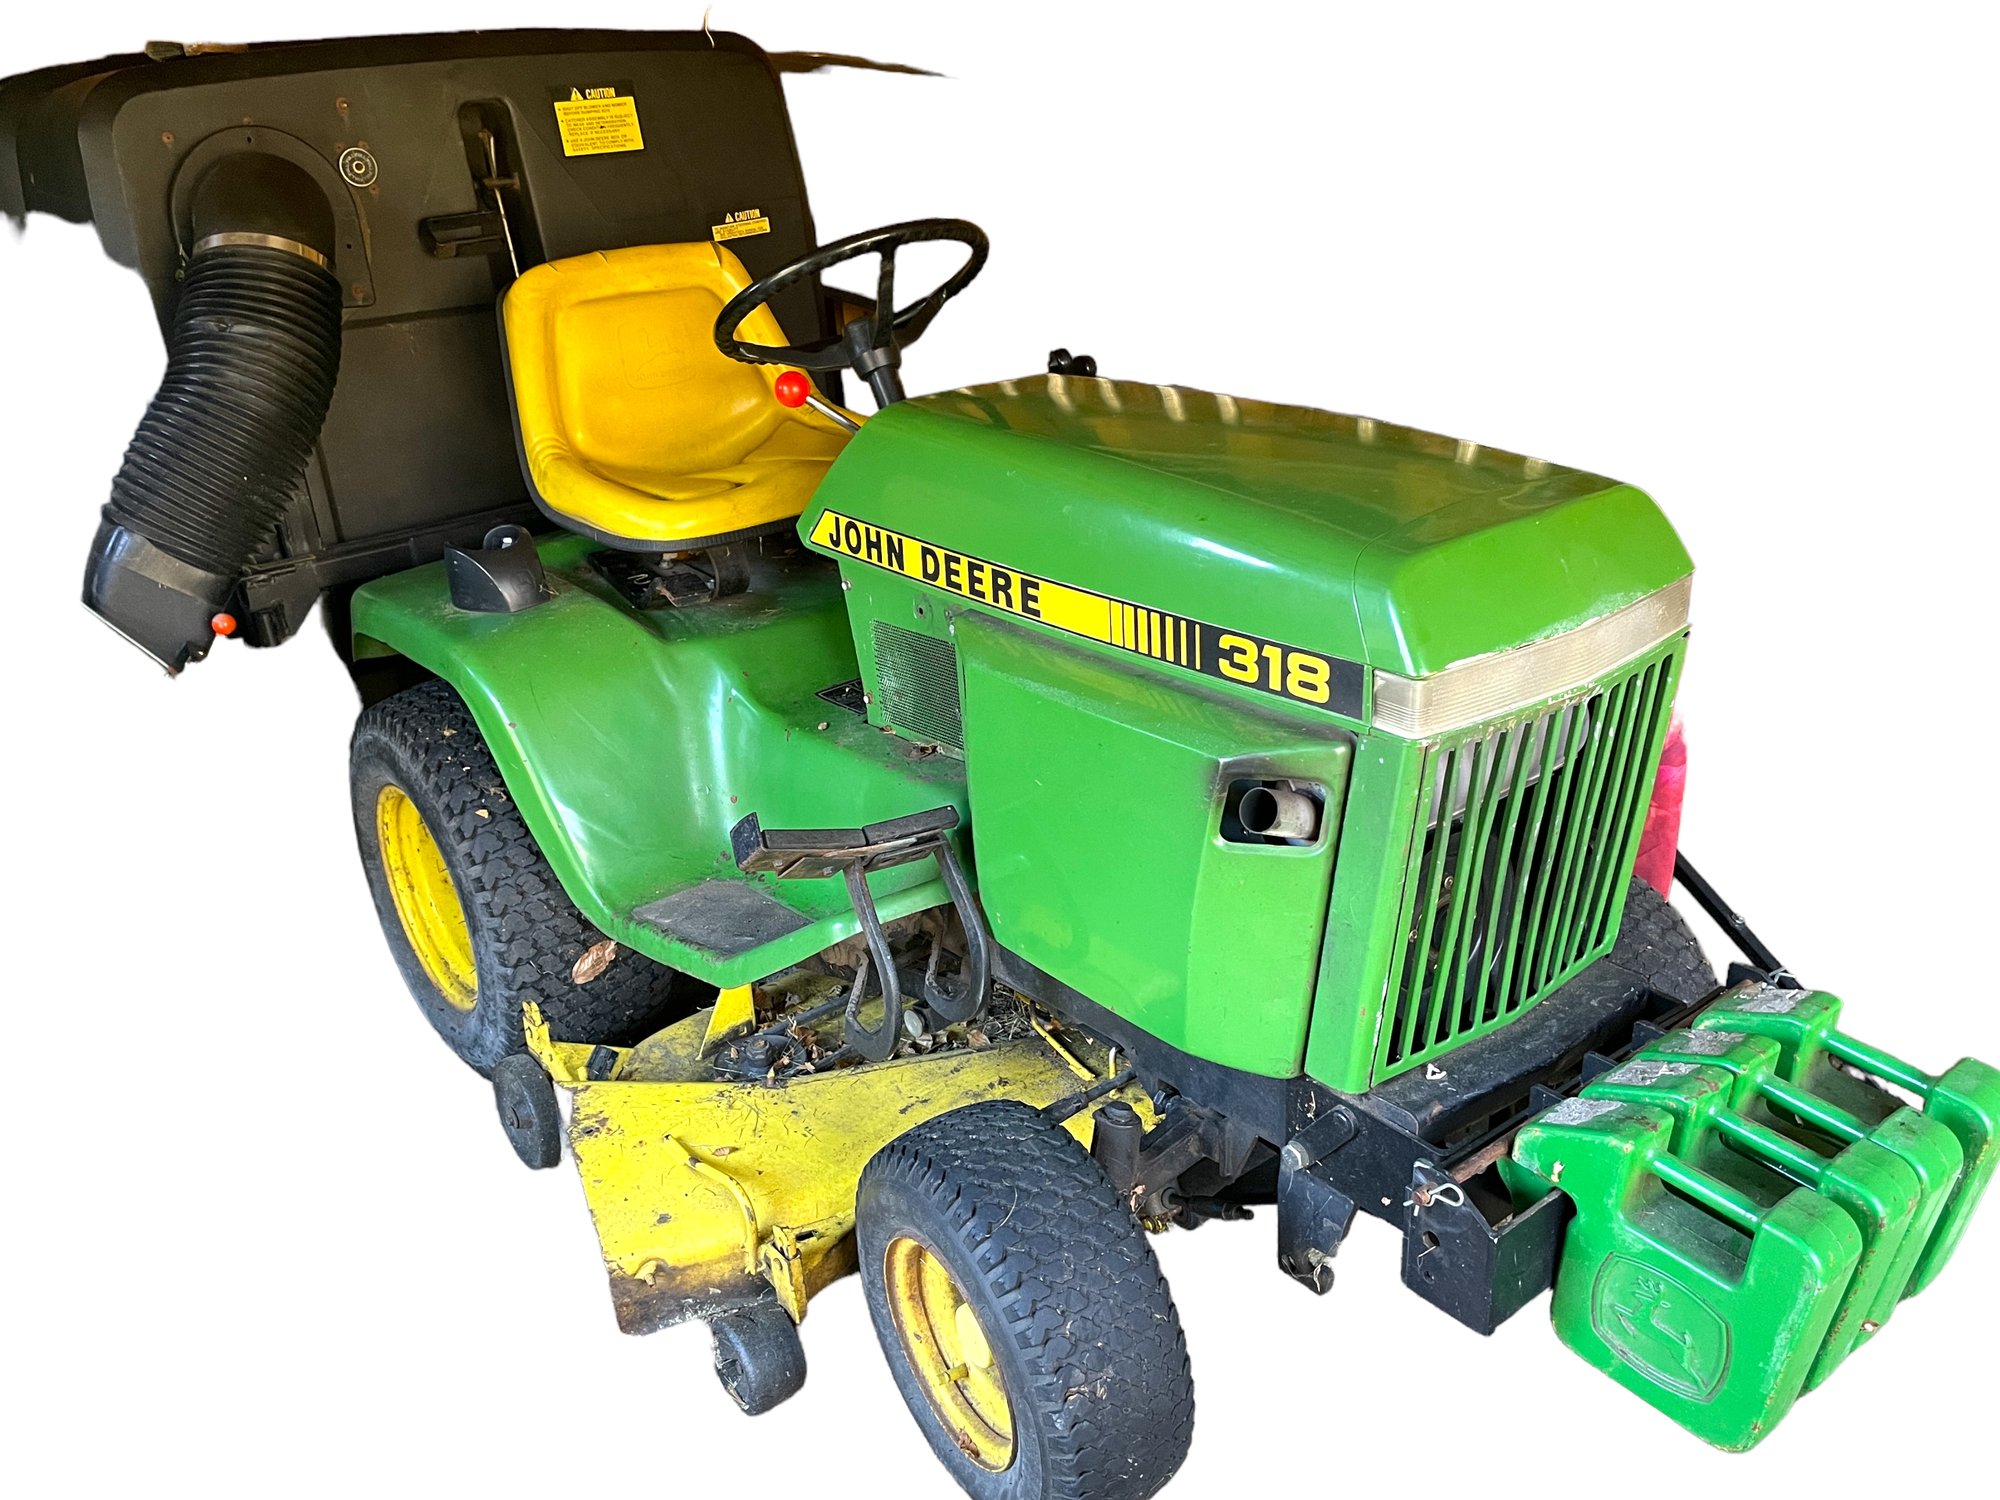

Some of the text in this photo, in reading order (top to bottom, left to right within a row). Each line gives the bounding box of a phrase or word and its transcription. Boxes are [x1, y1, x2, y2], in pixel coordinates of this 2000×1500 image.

[585, 87, 616, 99] CAUTION
[734, 209, 761, 221] CAUTION
[829, 516, 1042, 618] JOHN DEERE
[1217, 633, 1331, 704] 318
